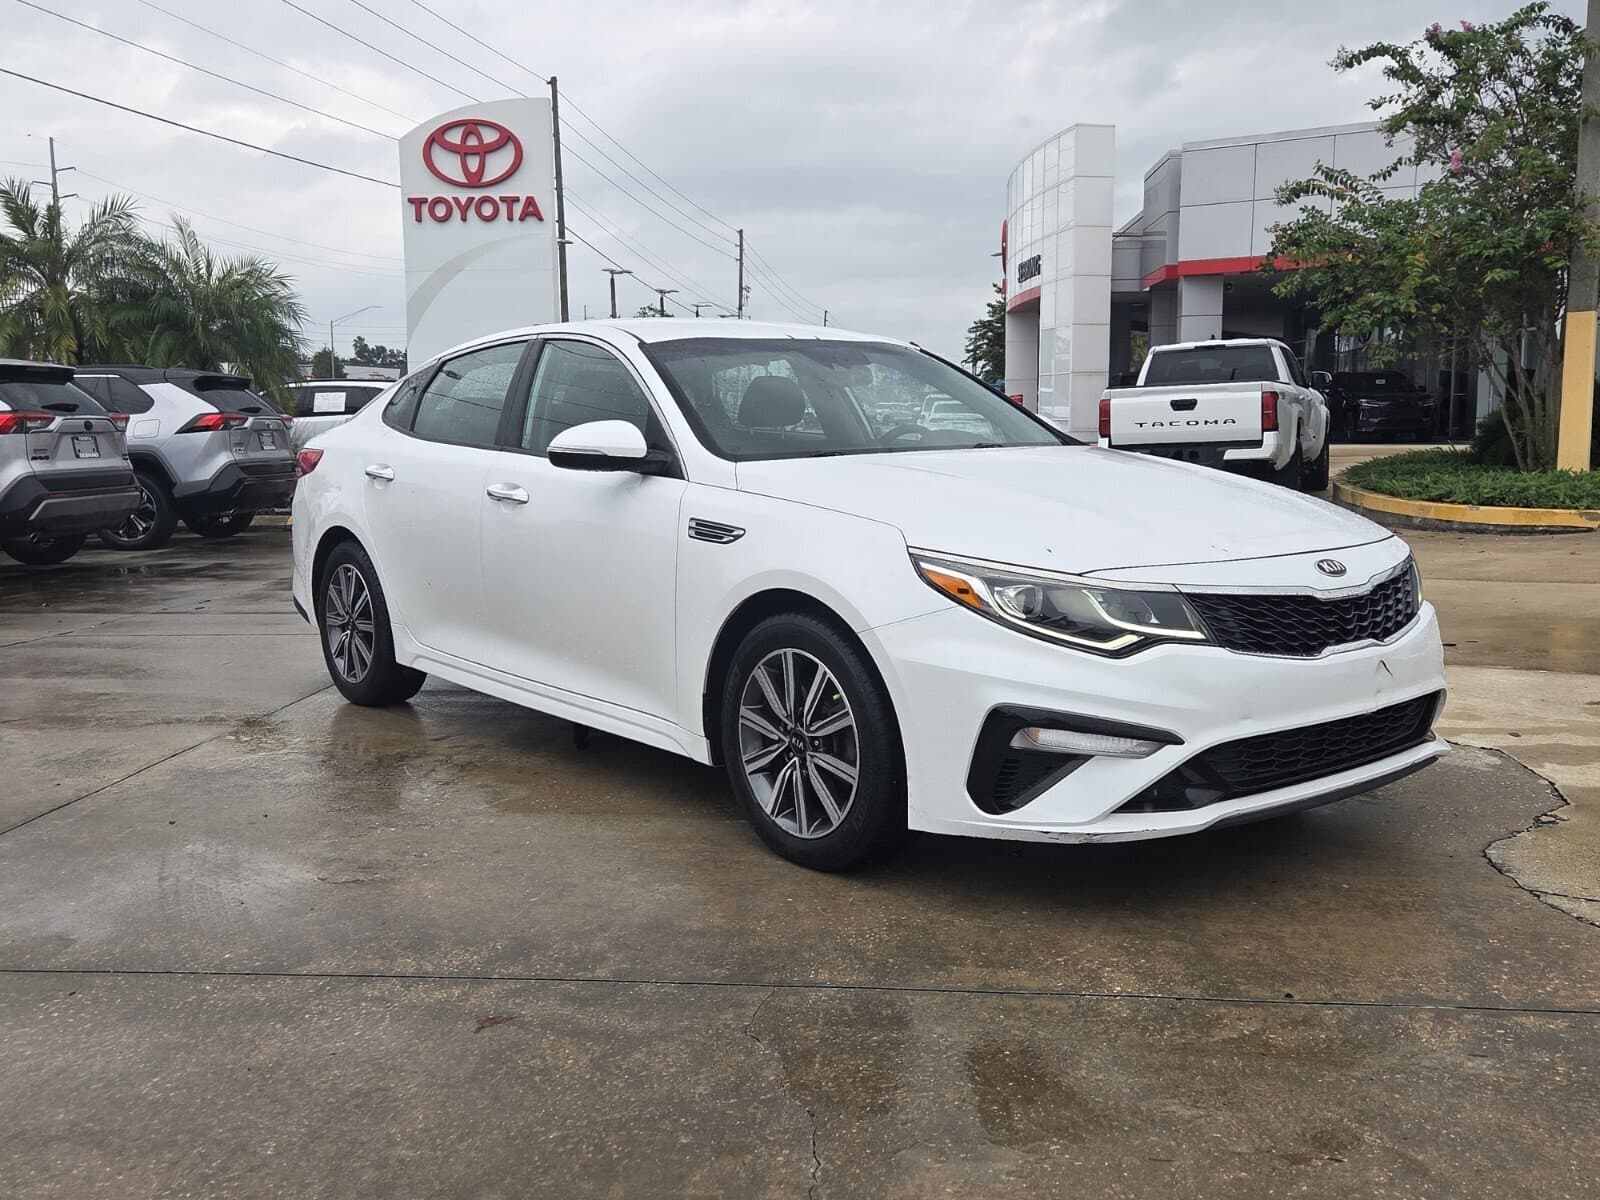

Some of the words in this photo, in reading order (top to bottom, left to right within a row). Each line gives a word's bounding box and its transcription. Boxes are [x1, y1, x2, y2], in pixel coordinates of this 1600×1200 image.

[407, 195, 544, 223] TOYOTA
[1134, 418, 1237, 428] TACOMA
[1319, 560, 1345, 573] KIA
